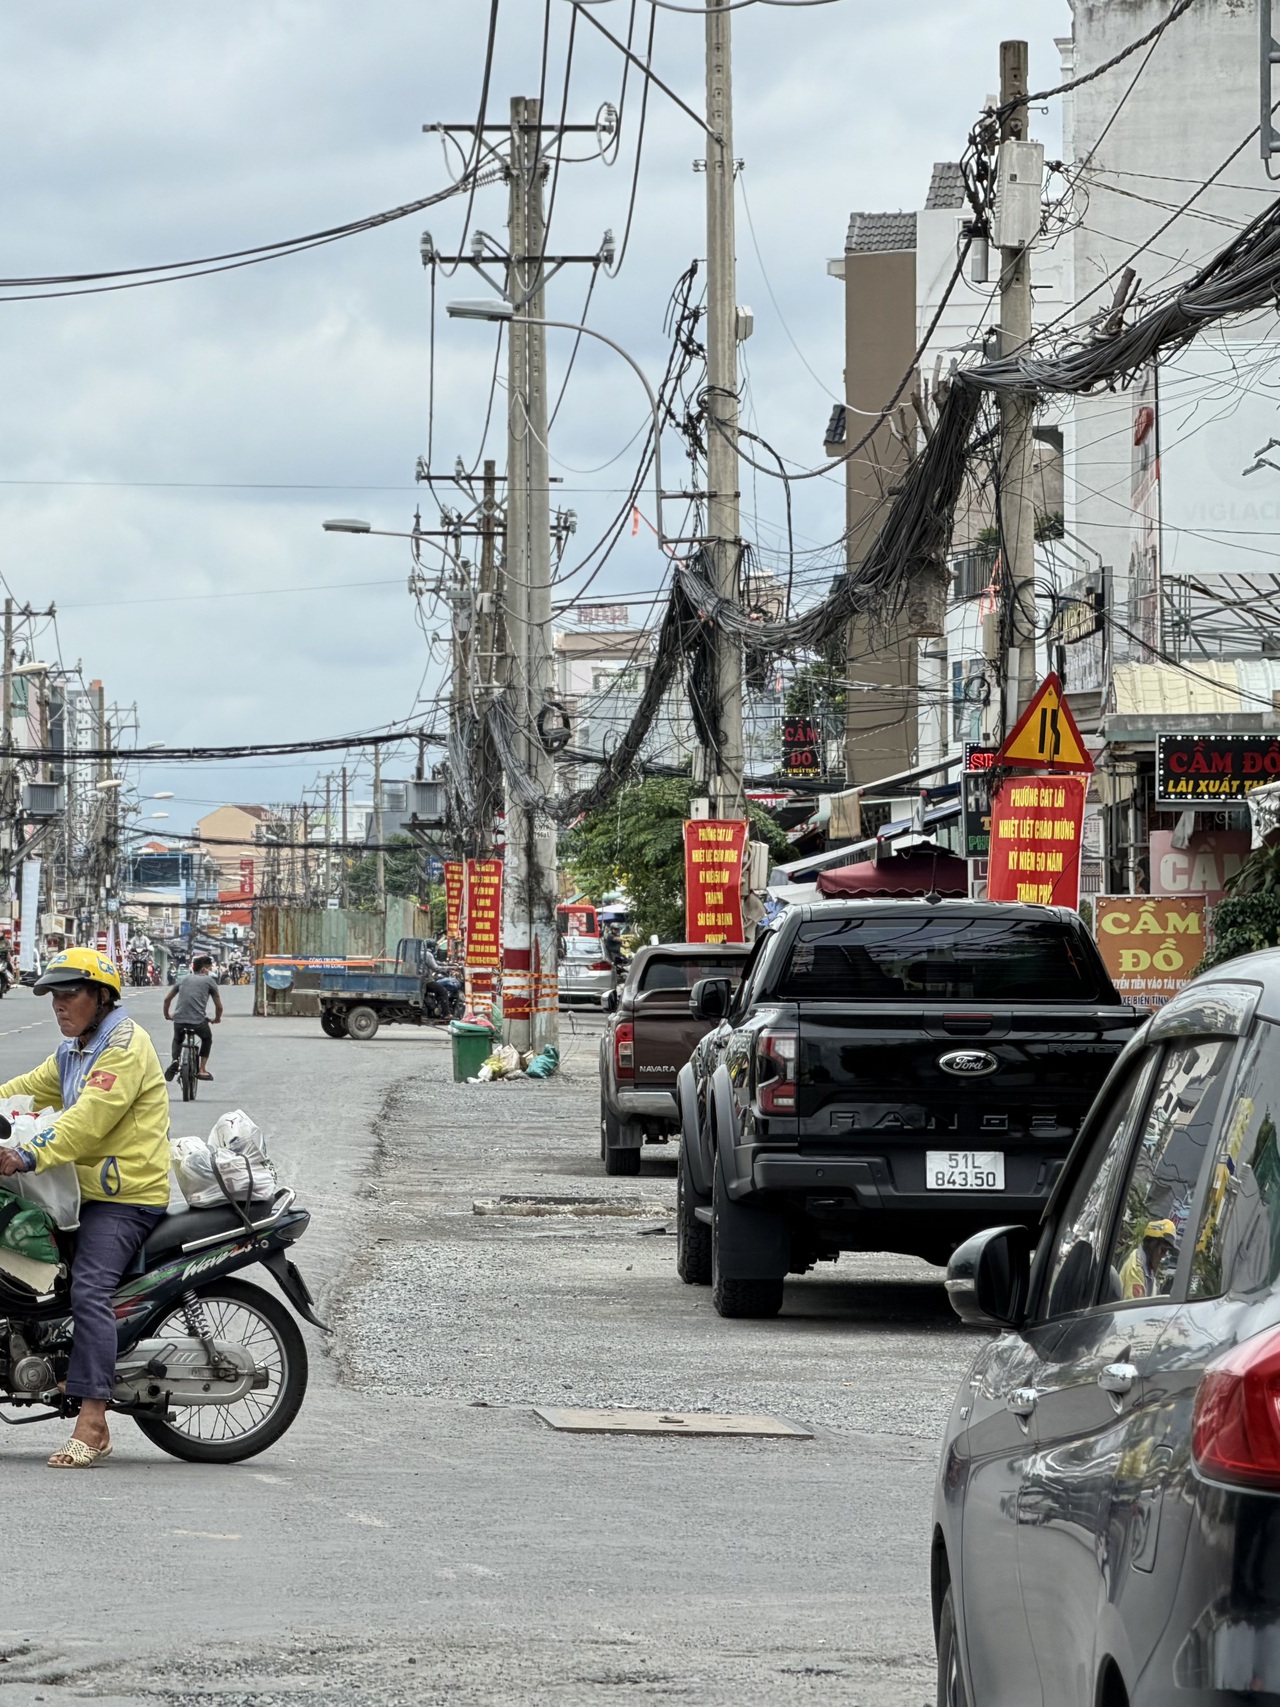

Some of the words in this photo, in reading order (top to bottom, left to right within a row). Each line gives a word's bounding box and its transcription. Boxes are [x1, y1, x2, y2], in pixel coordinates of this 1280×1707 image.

[785, 720, 819, 742] CẦM
[1169, 741, 1233, 773] CẦM
[1167, 776, 1194, 793] LÃI
[1196, 774, 1240, 793] XUẤT
[1010, 785, 1039, 807] PHƯỜNG
[1039, 786, 1053, 808] CÁT
[1054, 786, 1065, 808] LÁI
[998, 816, 1019, 842] NHIỆT
[1020, 816, 1034, 842] LIỆT
[1035, 817, 1053, 840] CHÀO
[1053, 818, 1075, 840] MỪNG
[1036, 852, 1046, 871] 50
[1046, 849, 1063, 872] NĂM
[1017, 880, 1038, 903] THÀNH
[1101, 901, 1202, 935] CẦM
[1118, 937, 1184, 972] ĐỒ
[1131, 974, 1147, 990] TIỀN
[1148, 976, 1163, 990] VÀO
[1164, 976, 1176, 990] TÀI
[1048, 1043, 1123, 1056] RAPTOR
[639, 1065, 677, 1073] NAVARA
[952, 1055, 984, 1071] Ford
[830, 1111, 1087, 1130] RANGE
[948, 1153, 982, 1169] 51L
[935, 1171, 996, 1187] 843.50
